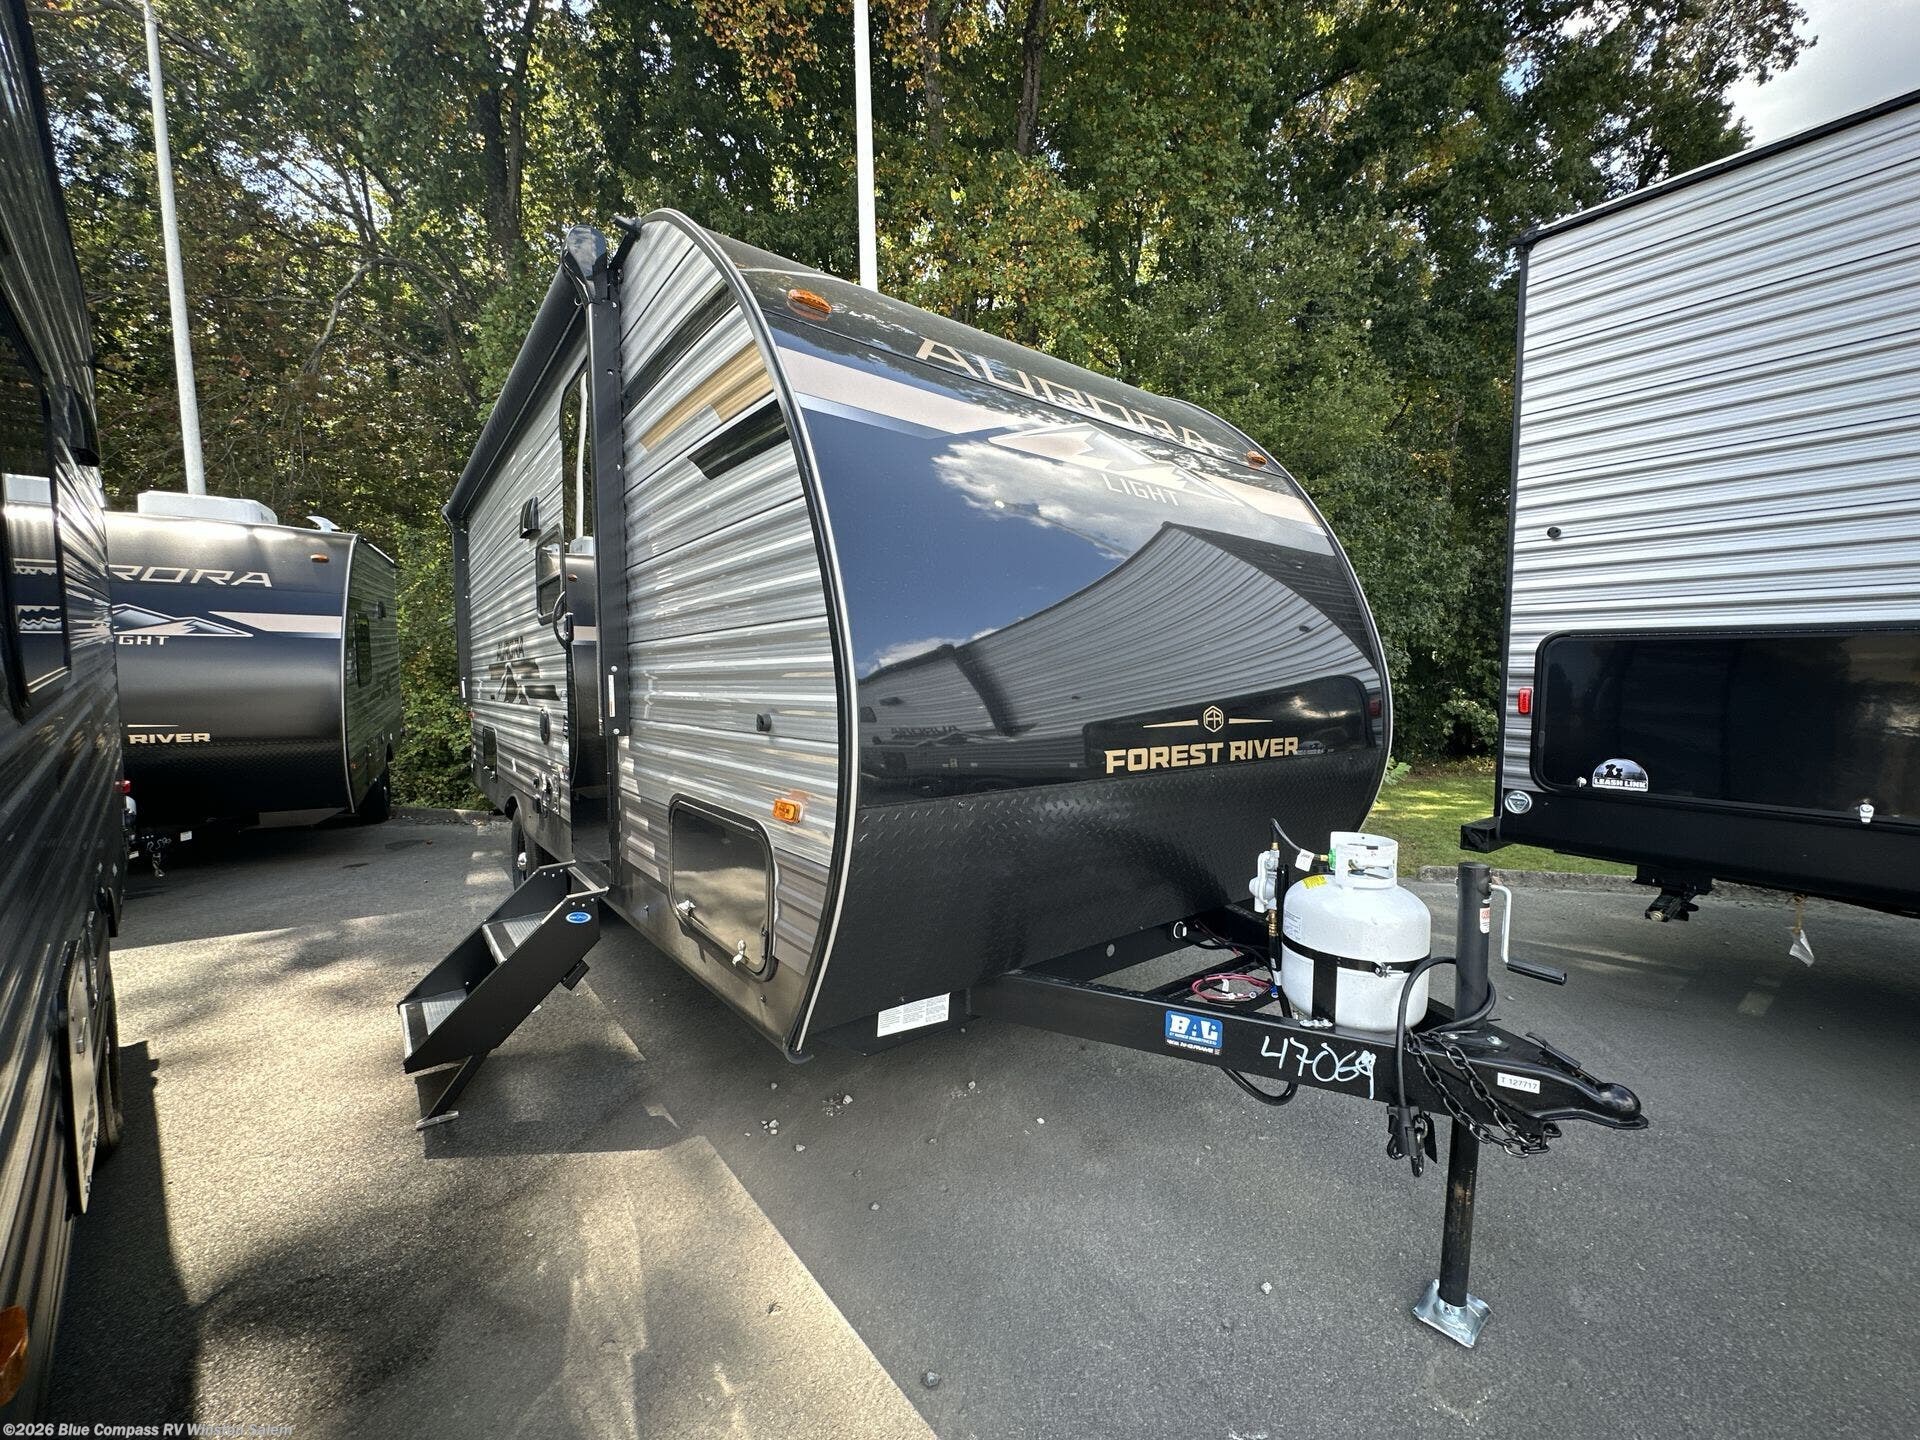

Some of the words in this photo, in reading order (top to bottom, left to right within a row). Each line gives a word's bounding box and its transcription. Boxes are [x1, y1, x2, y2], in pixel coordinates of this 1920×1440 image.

[914, 337, 1226, 457] AURORA
[1101, 473, 1180, 507] LIGHT
[118, 635, 171, 646] GHT
[127, 732, 211, 745] RIVER
[1103, 742, 1224, 774] FOREST
[1229, 736, 1299, 761] RIVER
[1594, 778, 1623, 786] LEASH
[1624, 780, 1646, 788] LINK
